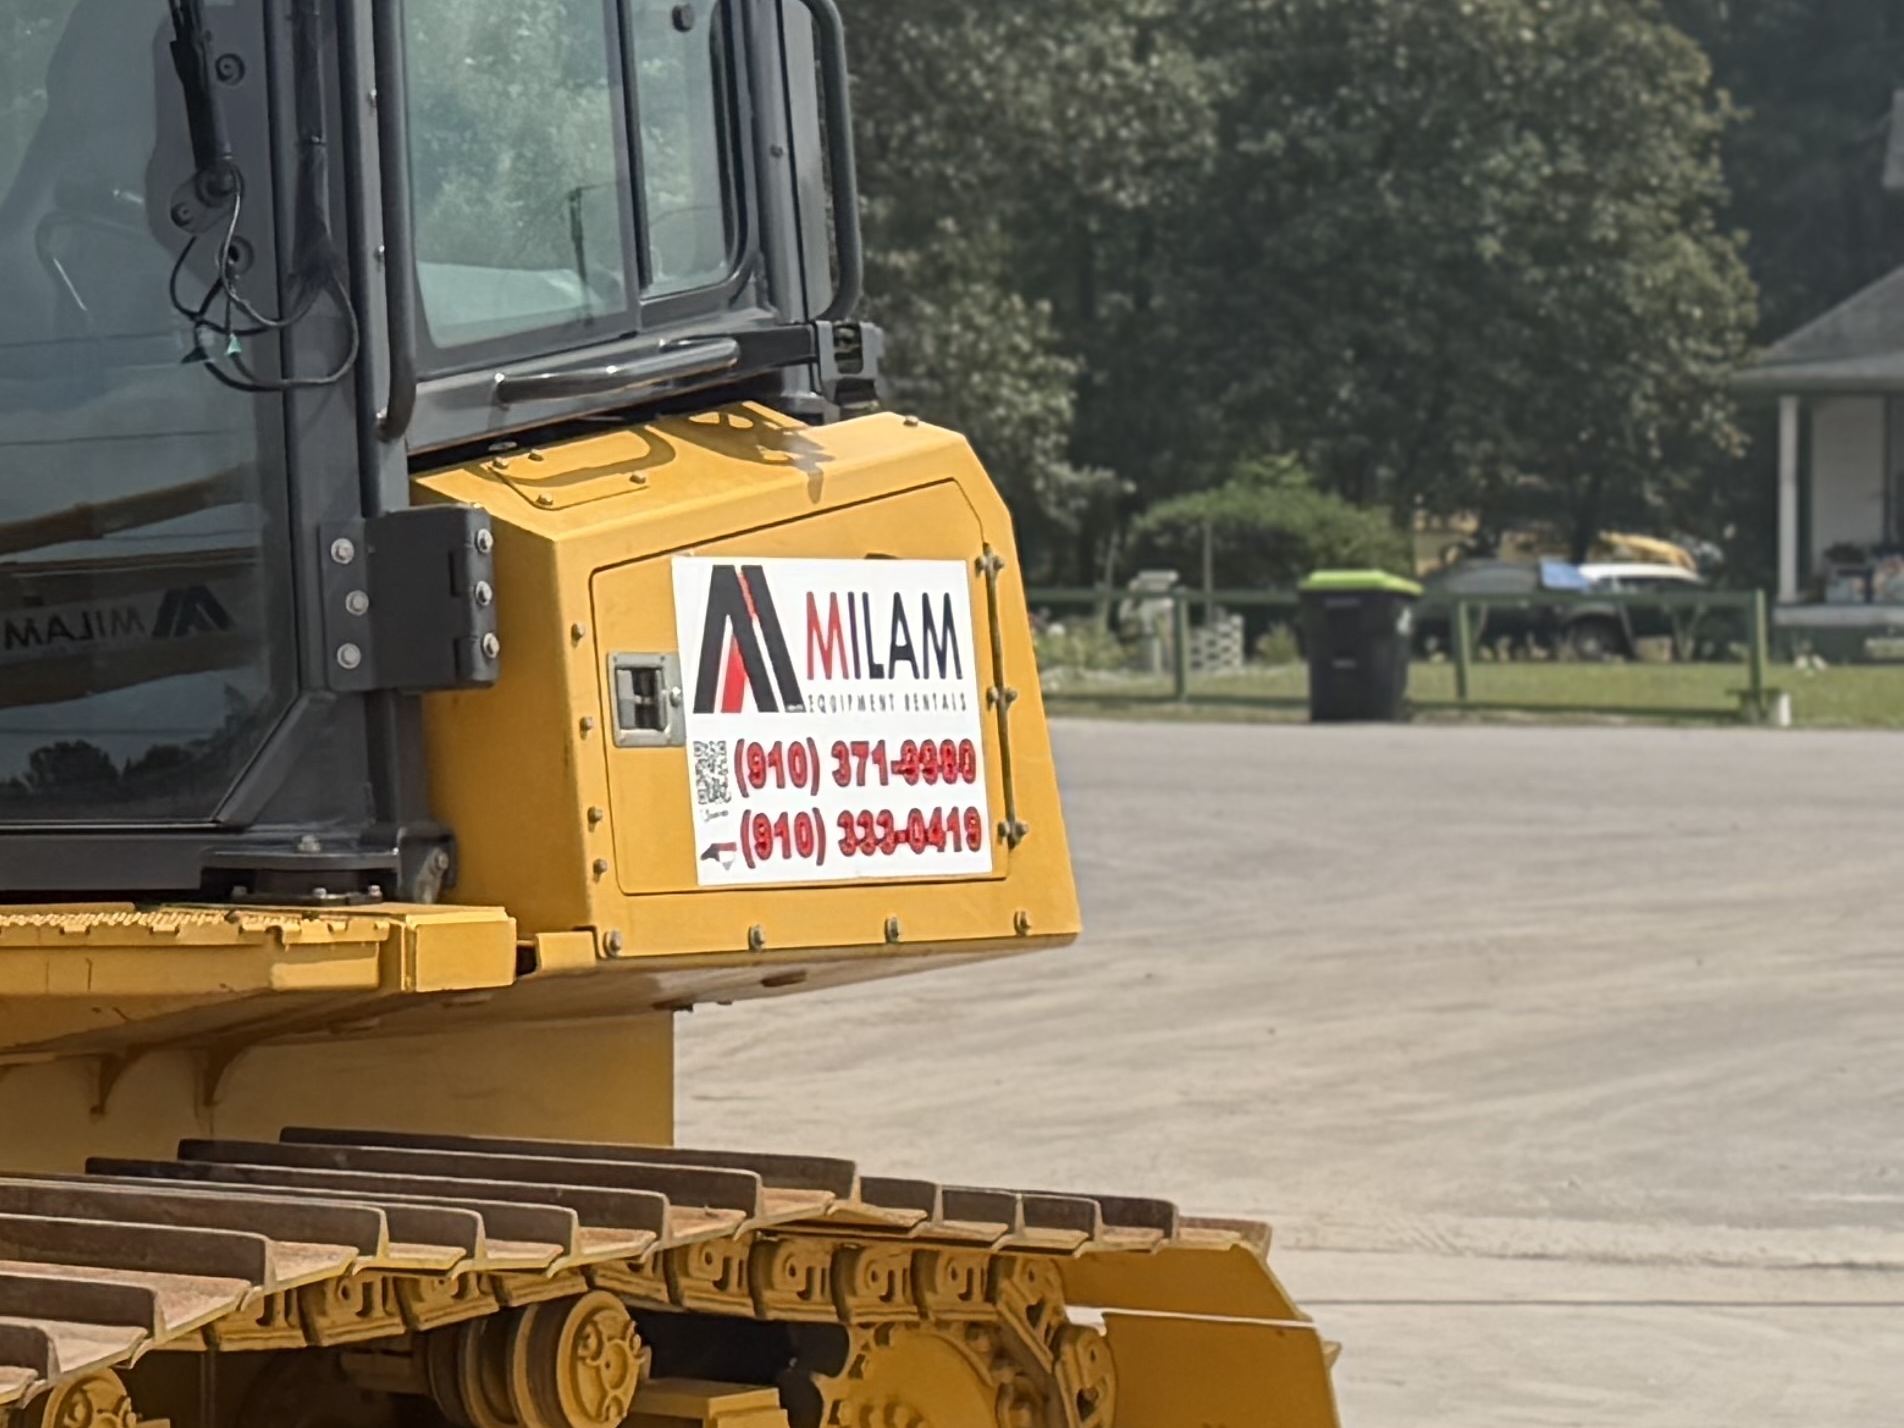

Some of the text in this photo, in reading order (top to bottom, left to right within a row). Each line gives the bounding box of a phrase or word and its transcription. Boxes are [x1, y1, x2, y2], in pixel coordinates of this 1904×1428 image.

[806, 592, 963, 680] MILAM
[808, 693, 895, 714] EQUIPMENT
[734, 737, 821, 798] (910)
[740, 806, 982, 869] (910) 333-0419
